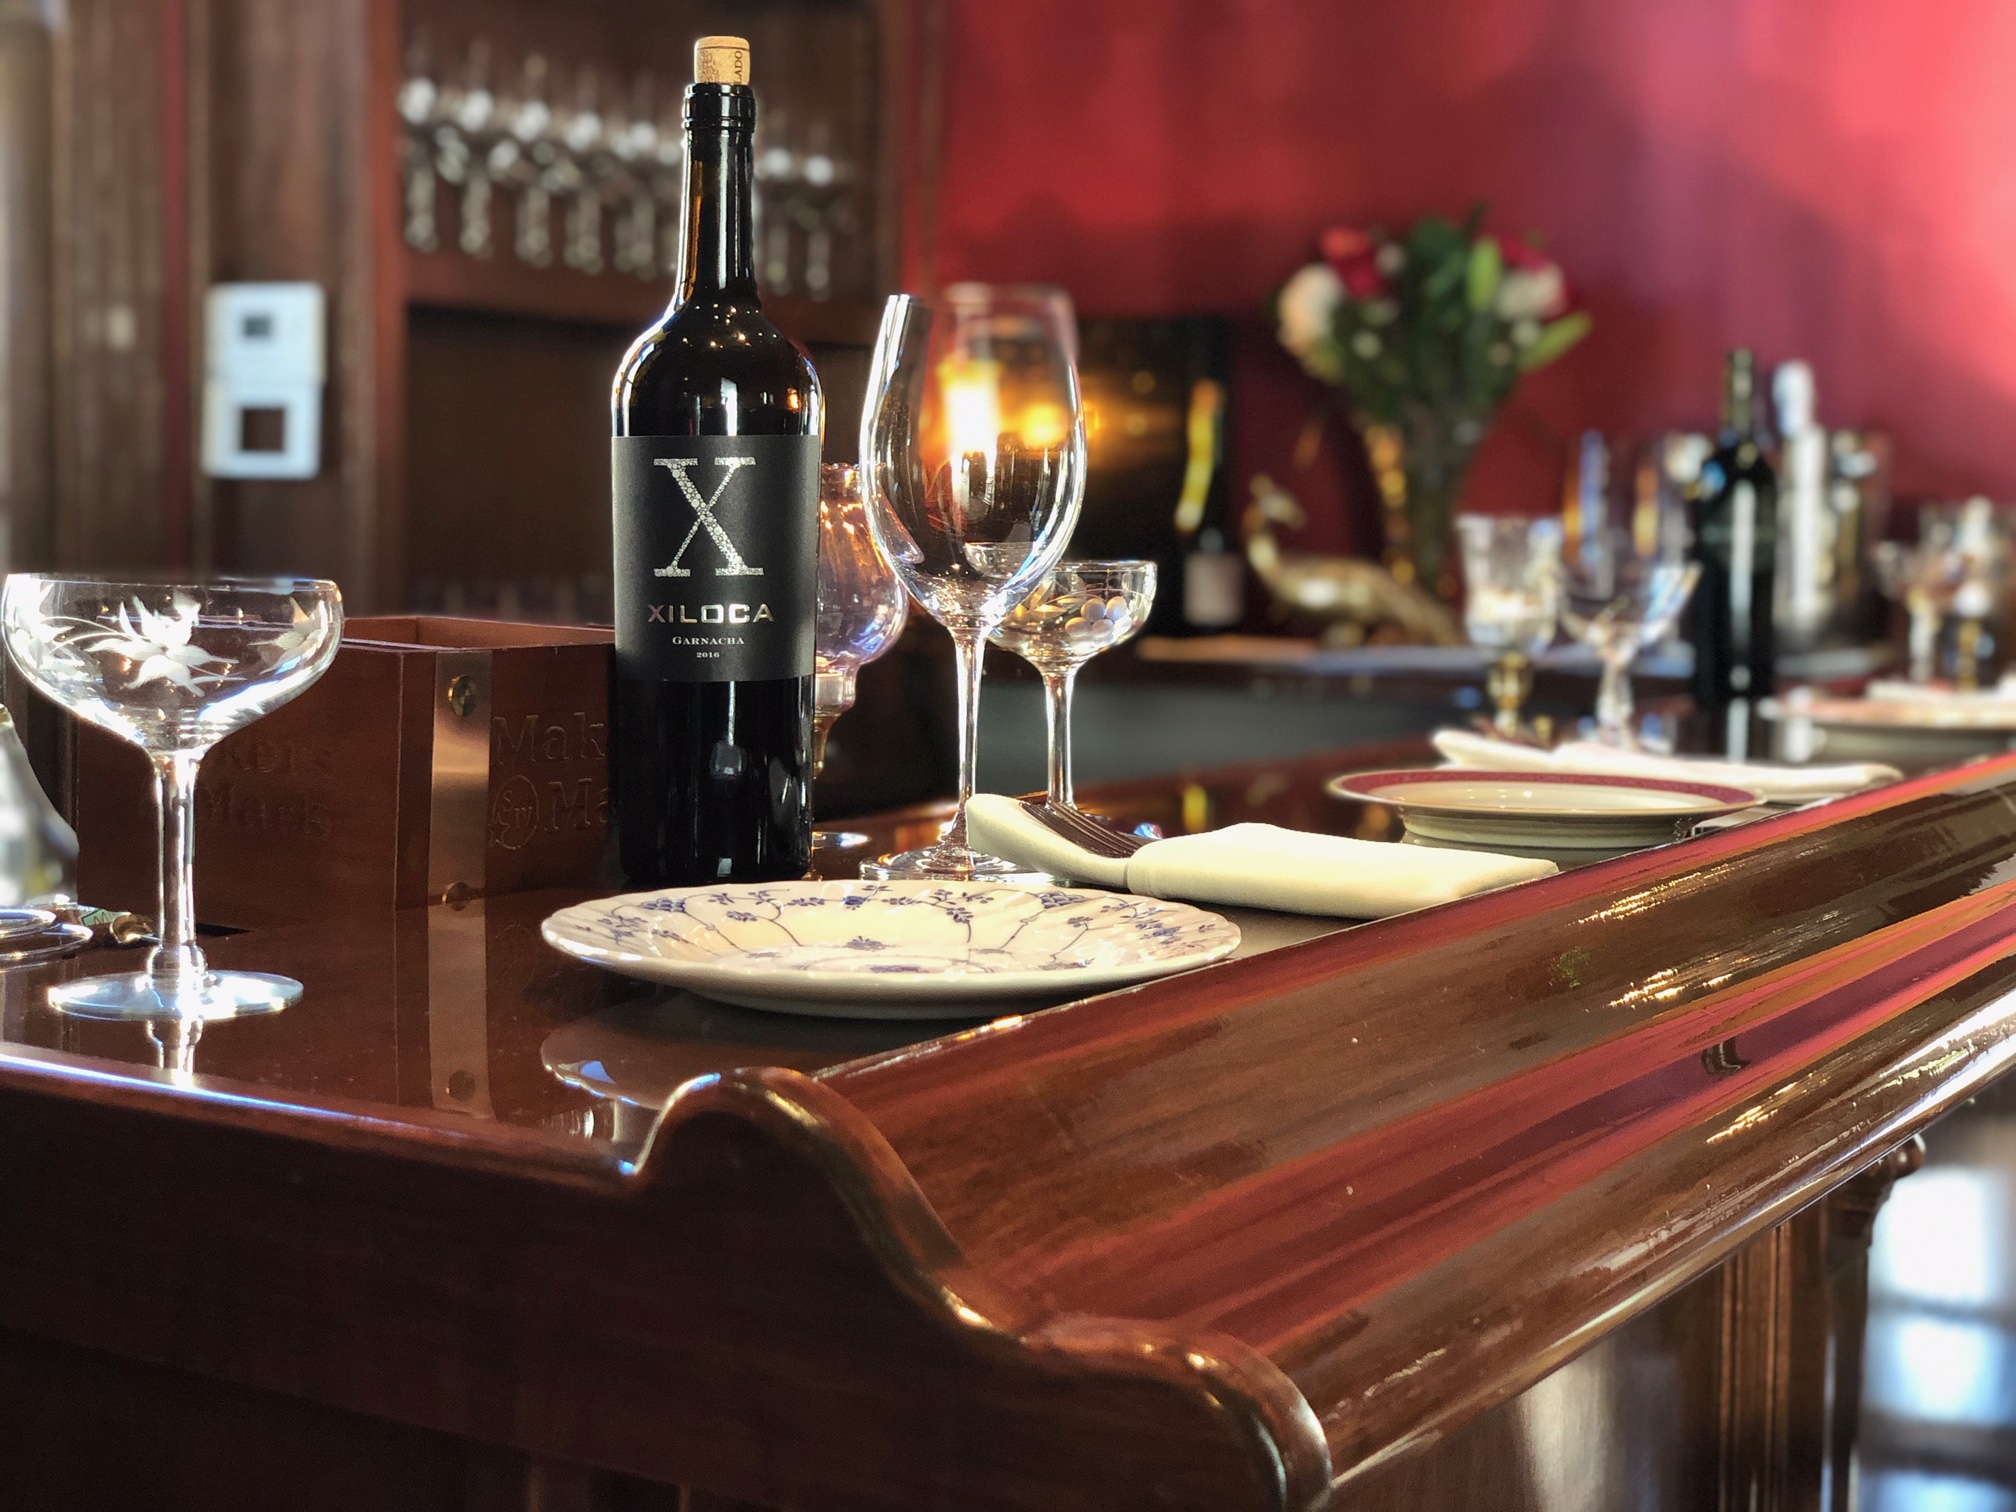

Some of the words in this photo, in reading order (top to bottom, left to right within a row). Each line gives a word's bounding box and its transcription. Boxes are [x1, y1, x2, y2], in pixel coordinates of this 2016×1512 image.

[653, 457, 764, 577] X
[648, 603, 774, 624] XILOCA
[672, 636, 745, 645] GARNACHA
[696, 651, 720, 659] 2016
[491, 711, 606, 765] Mak
